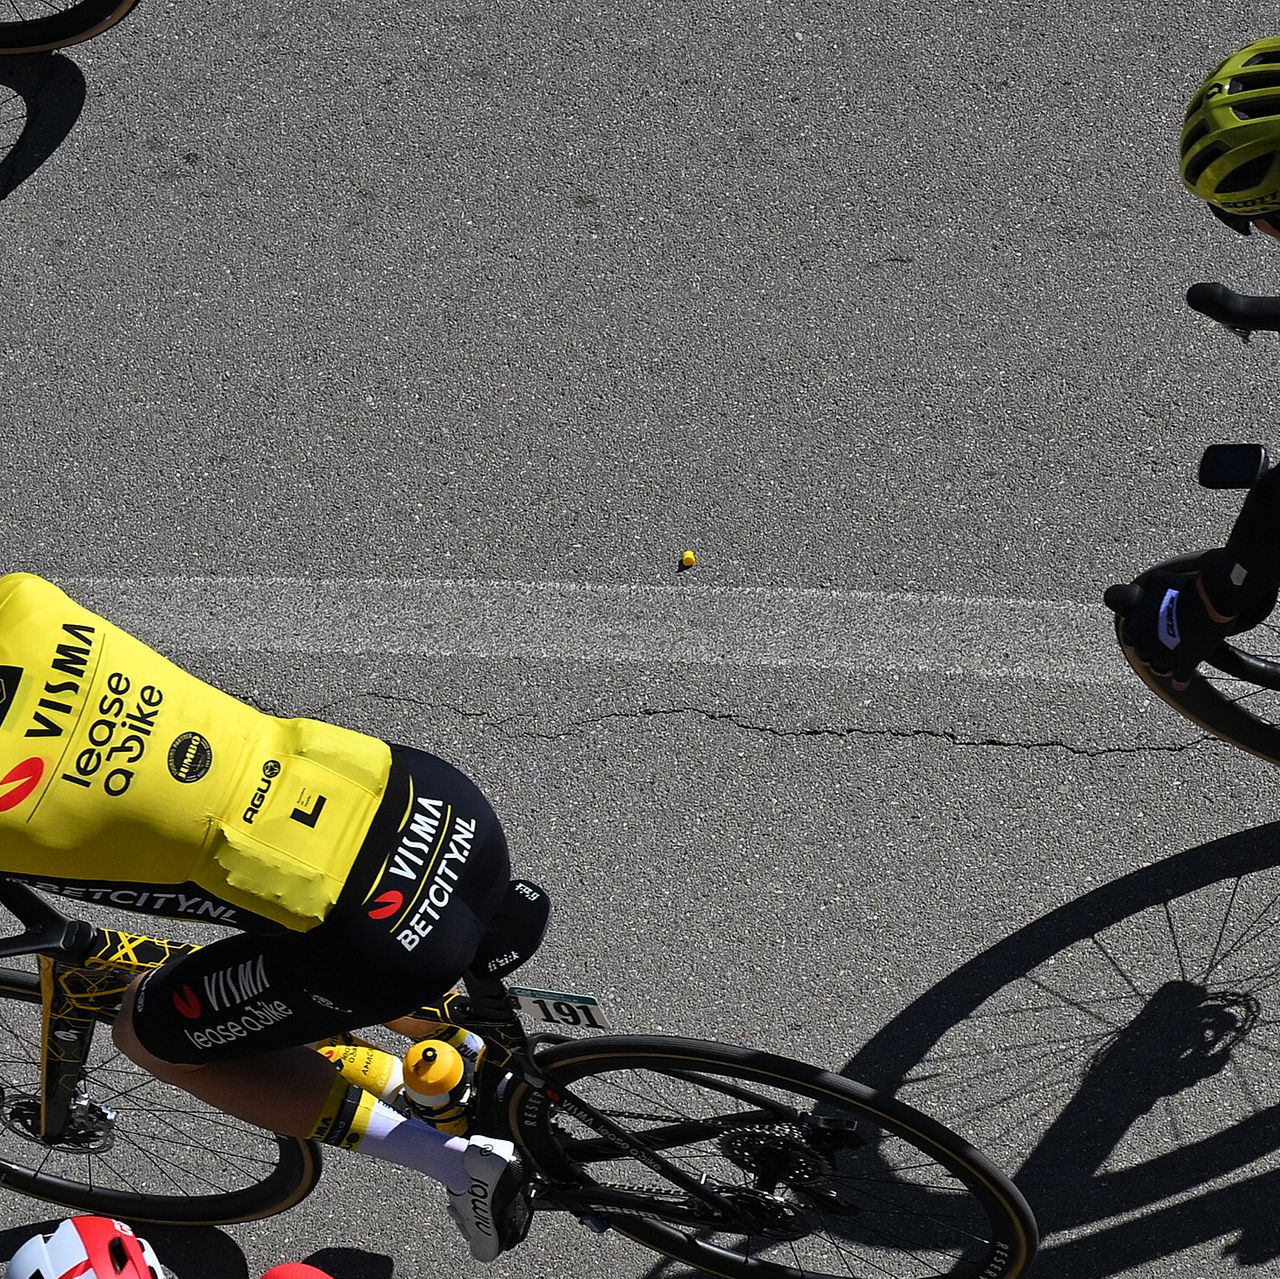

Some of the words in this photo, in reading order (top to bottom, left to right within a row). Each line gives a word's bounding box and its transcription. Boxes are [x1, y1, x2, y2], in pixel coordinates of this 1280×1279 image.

[24, 623, 95, 737] VISMA
[60, 672, 130, 789] lease
[178, 735, 201, 780] JUMBO
[242, 777, 272, 825] AGU
[389, 796, 444, 881] VISMA
[35, 880, 238, 924] BETCITY.NL
[396, 817, 477, 952] BETCITY.NL
[203, 954, 271, 1012] VISMA
[183, 1020, 248, 1050] lease
[532, 998, 607, 1029] 191
[562, 1098, 595, 1127] VISMA
